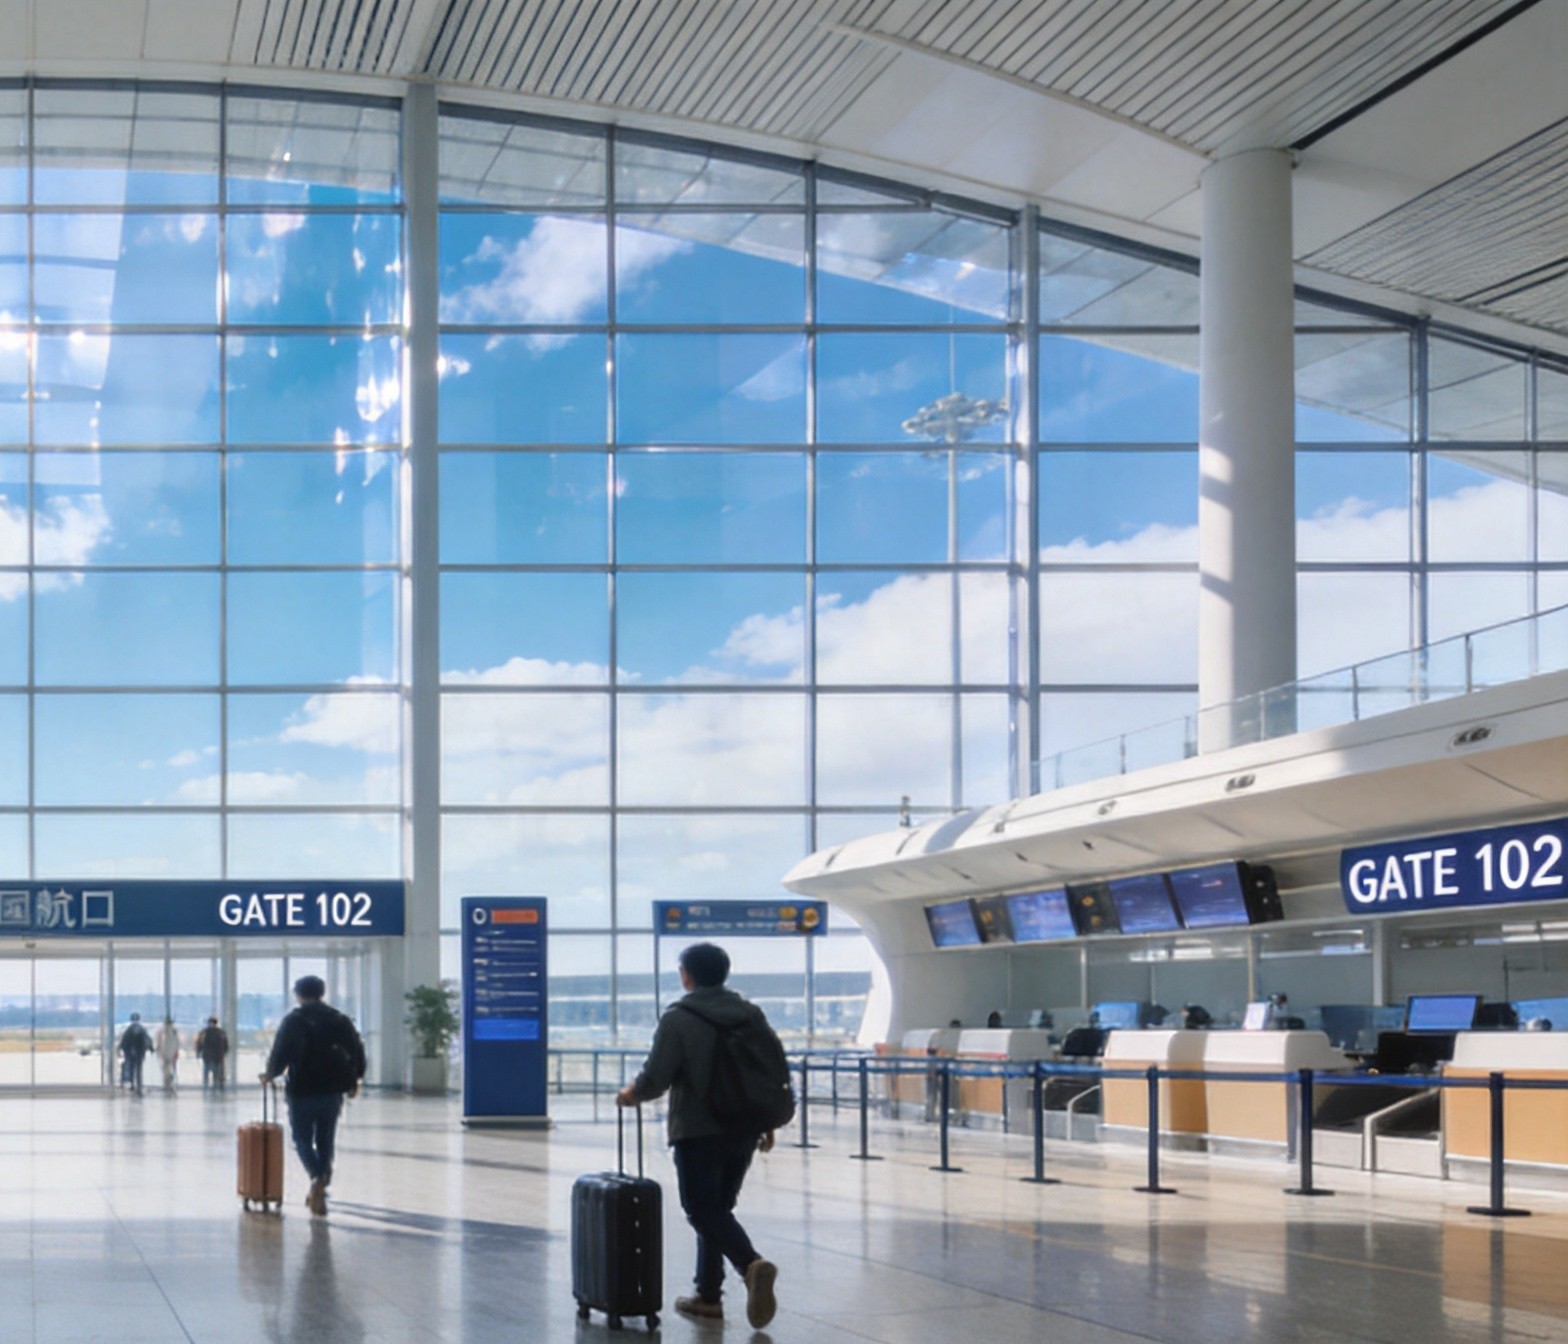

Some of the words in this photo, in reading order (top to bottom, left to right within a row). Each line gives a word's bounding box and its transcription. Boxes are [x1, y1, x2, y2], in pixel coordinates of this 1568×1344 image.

[1348, 847, 1459, 903] GATE
[1474, 834, 1564, 891] 102
[218, 893, 305, 926] GATE
[316, 892, 372, 926] 102
